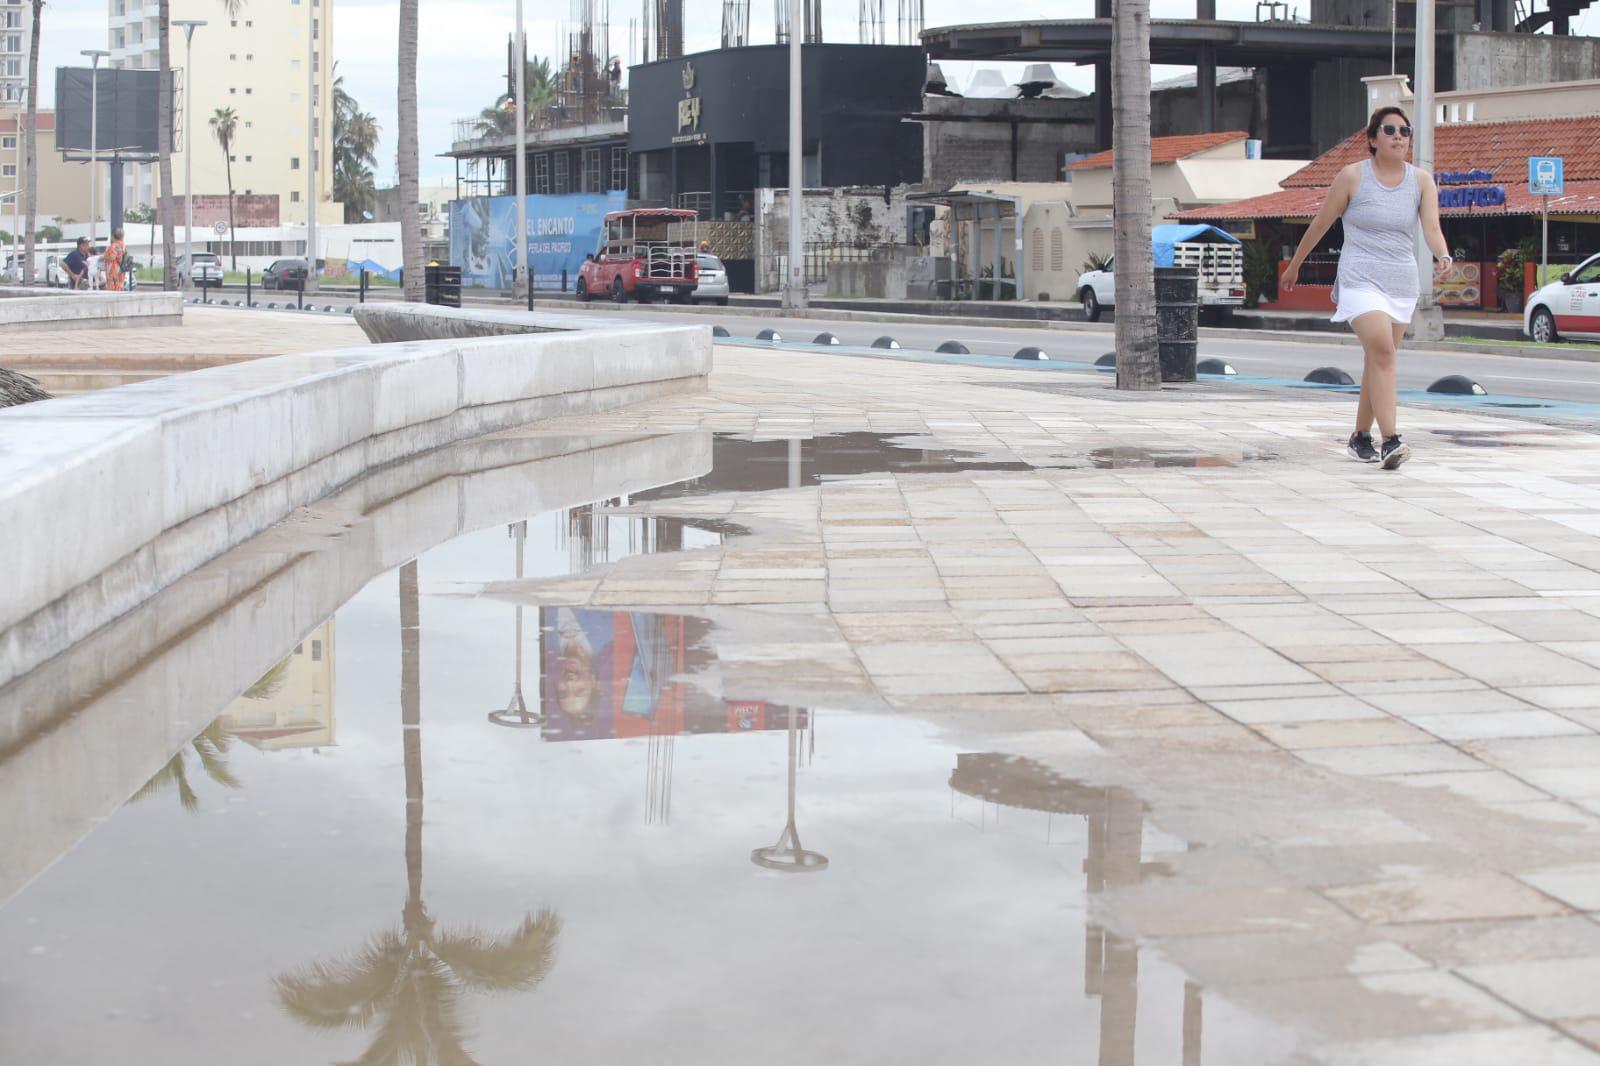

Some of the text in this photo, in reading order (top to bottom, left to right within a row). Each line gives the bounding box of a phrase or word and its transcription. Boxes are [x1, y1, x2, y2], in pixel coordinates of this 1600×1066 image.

[1439, 186, 1506, 207] ACIFICO
[527, 216, 574, 236] EL ENCANTO
